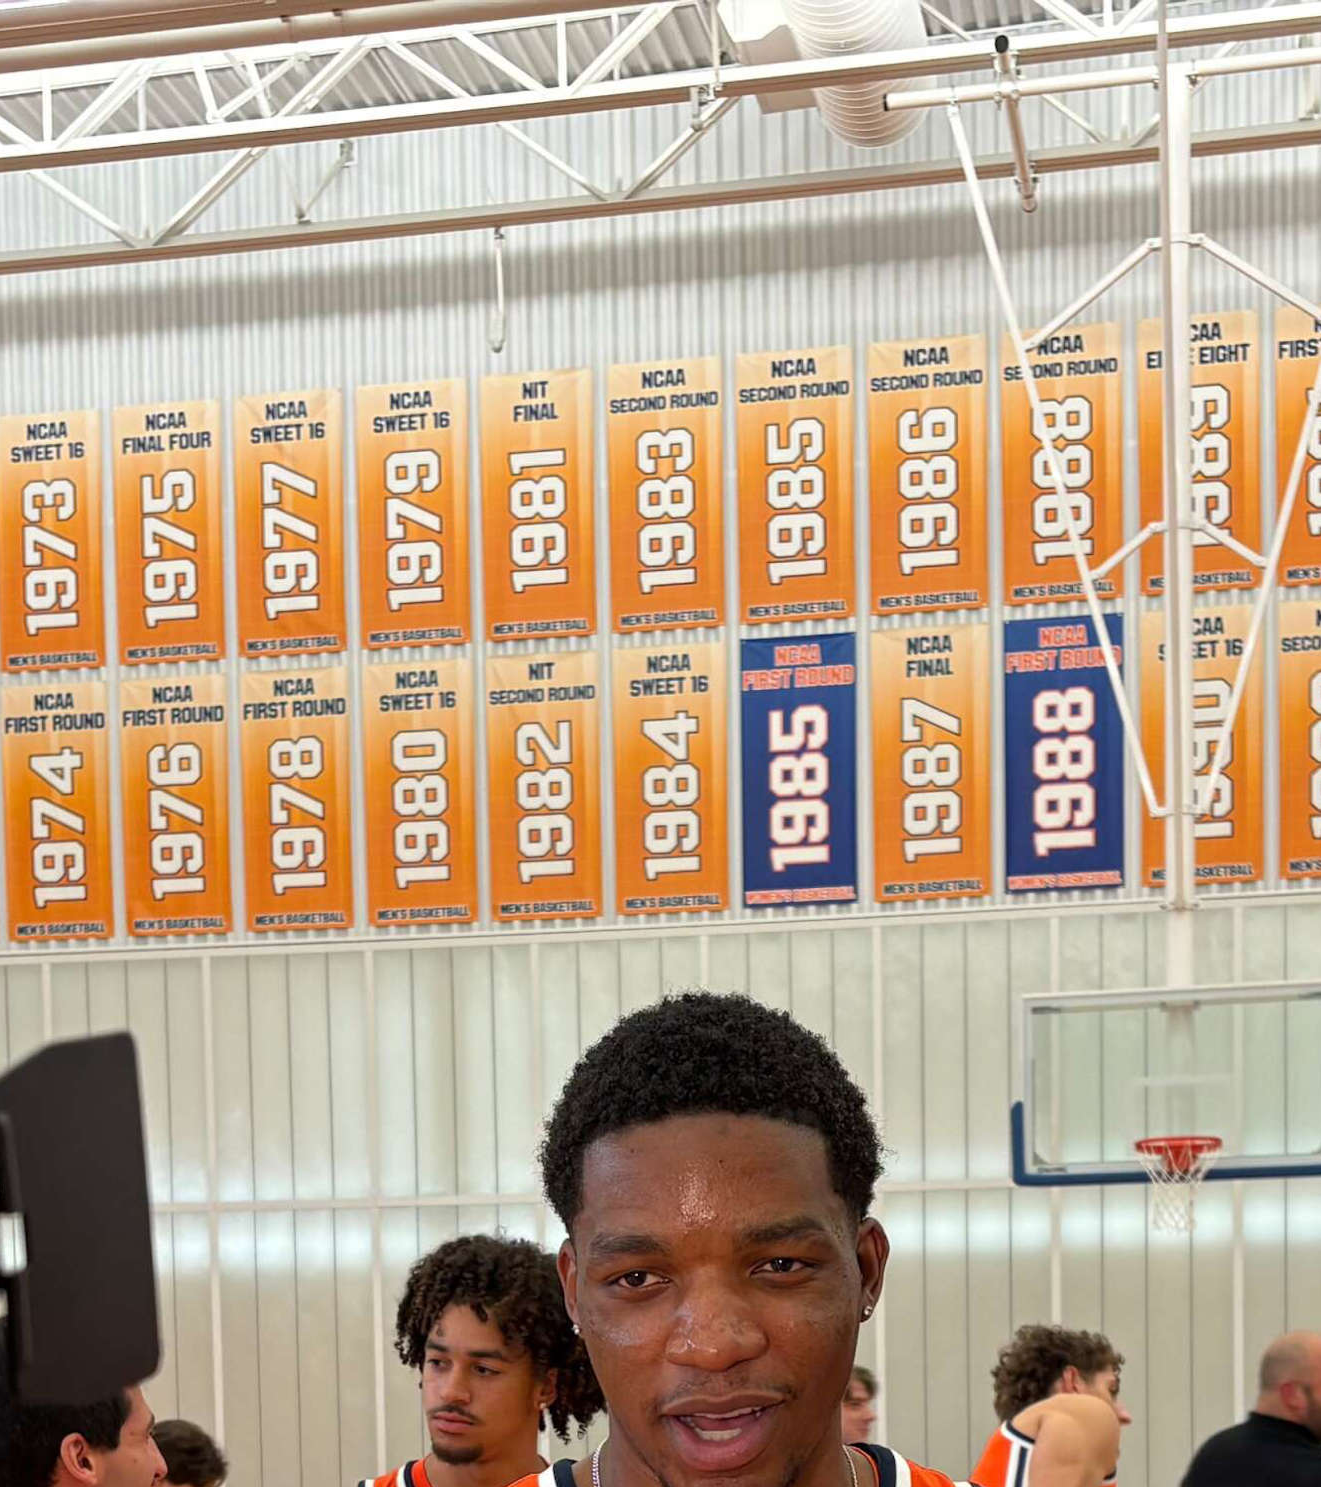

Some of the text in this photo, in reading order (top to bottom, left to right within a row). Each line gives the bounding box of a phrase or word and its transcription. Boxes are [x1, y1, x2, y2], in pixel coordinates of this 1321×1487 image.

[1199, 342, 1250, 364] EIGHT
[771, 358, 816, 377] NCAA
[522, 382, 548, 400] NIT
[739, 380, 849, 403] SECOND ROUND
[265, 401, 307, 420] NCAA
[514, 402, 558, 422] FINAL
[26, 422, 67, 440] NCAA
[250, 422, 324, 444] SWEET 16
[11, 442, 84, 462] SWEET 16
[898, 407, 959, 576] 1986
[1032, 396, 1093, 565] 1988
[636, 428, 696, 594] 1983
[766, 417, 826, 585] 1985
[384, 450, 444, 612] 1979
[508, 448, 568, 592] 1981
[140, 469, 198, 628] 1975
[262, 462, 319, 620] 1977
[22, 479, 78, 636] 1973
[775, 644, 820, 664] NCAA
[907, 635, 952, 655] NCAA
[528, 662, 554, 680] NIT
[742, 665, 854, 691] FIRST ROUND
[906, 659, 953, 678] FINAL
[273, 678, 315, 696] NCAA
[490, 683, 595, 704] SECOND ROUND
[34, 693, 73, 711] NCAA
[244, 697, 346, 718] FIRST ROUND
[5, 713, 104, 734] FIRST ROUND
[901, 697, 962, 863] 1987
[1033, 686, 1096, 857] 1988
[641, 711, 701, 880] 1984
[769, 704, 831, 873] 1985
[390, 730, 451, 889] 1980
[515, 721, 574, 884] 1982
[29, 747, 86, 908] 1974
[147, 743, 206, 900] 1976
[268, 736, 326, 895] 1978
[884, 879, 981, 894] MEN'S BASKETBALL
